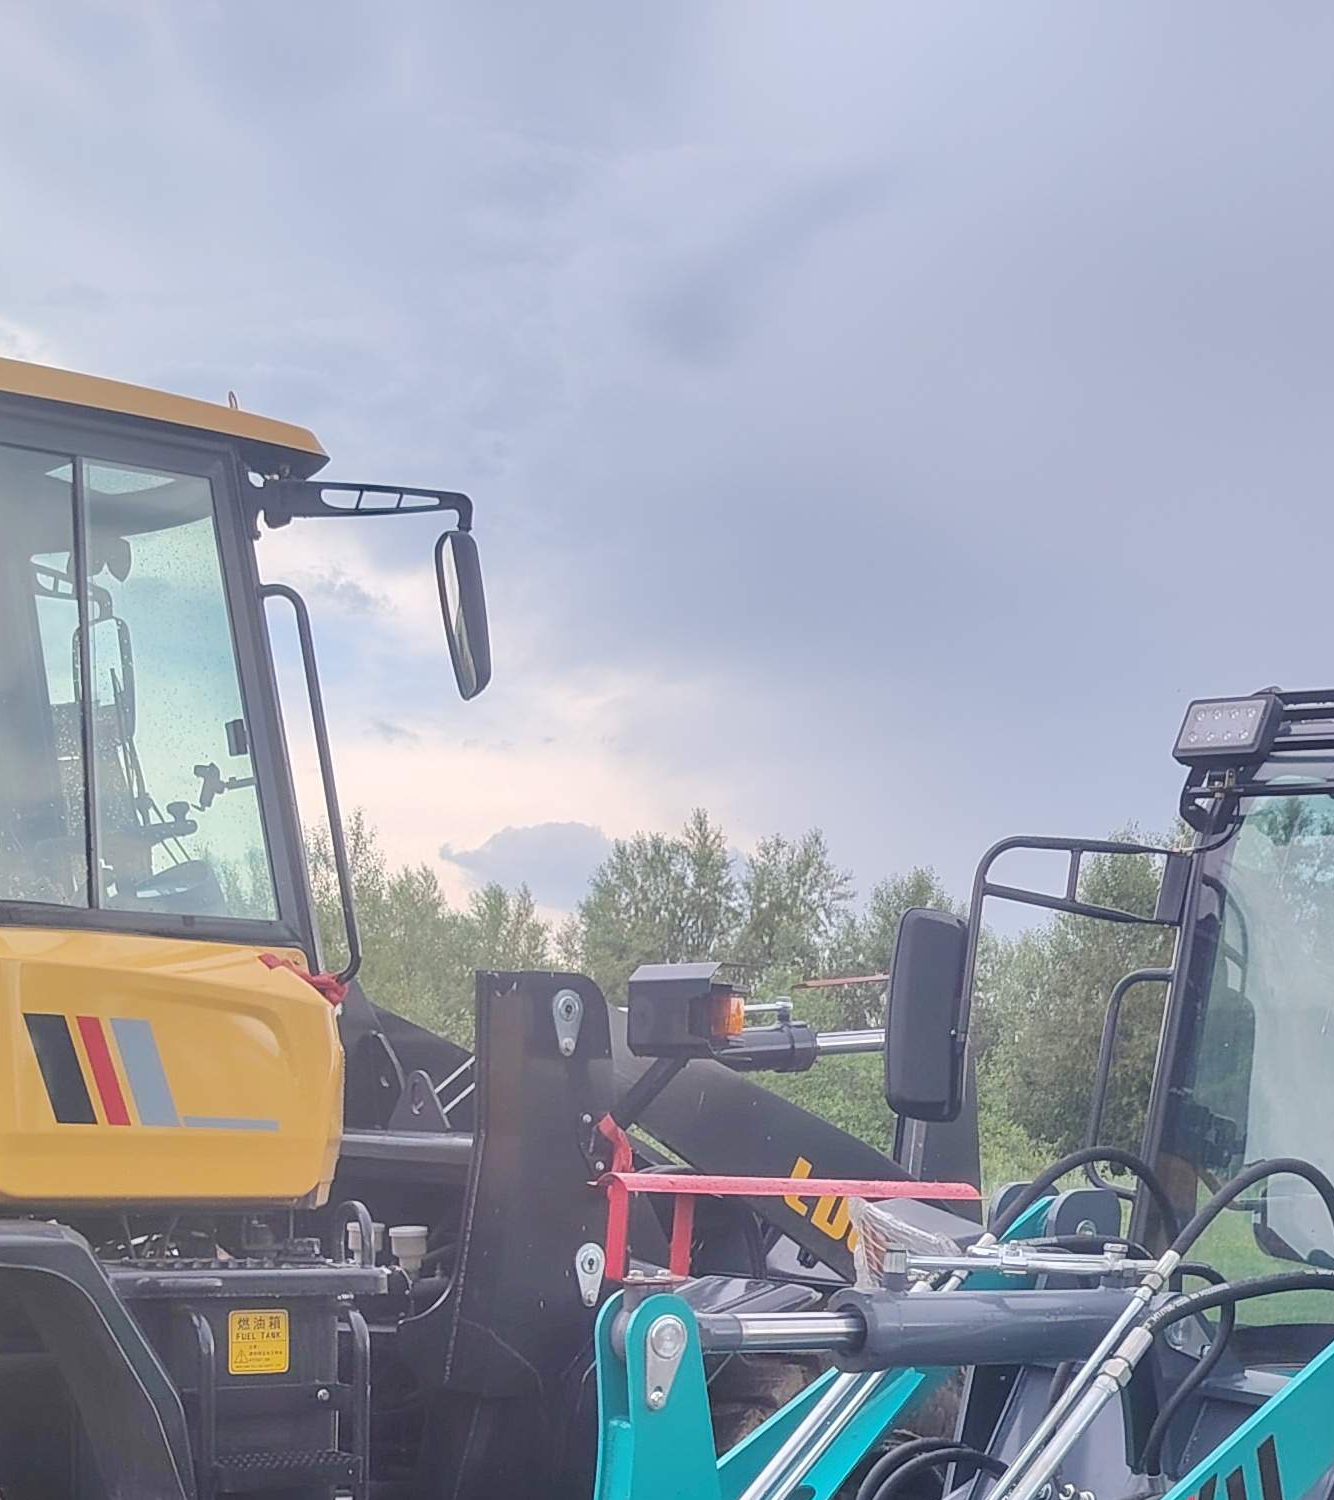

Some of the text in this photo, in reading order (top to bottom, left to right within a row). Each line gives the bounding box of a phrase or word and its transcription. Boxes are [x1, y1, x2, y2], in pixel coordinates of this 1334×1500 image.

[237, 1315, 281, 1331] 燃油箱
[235, 1331, 282, 1341] FUEL TANK
